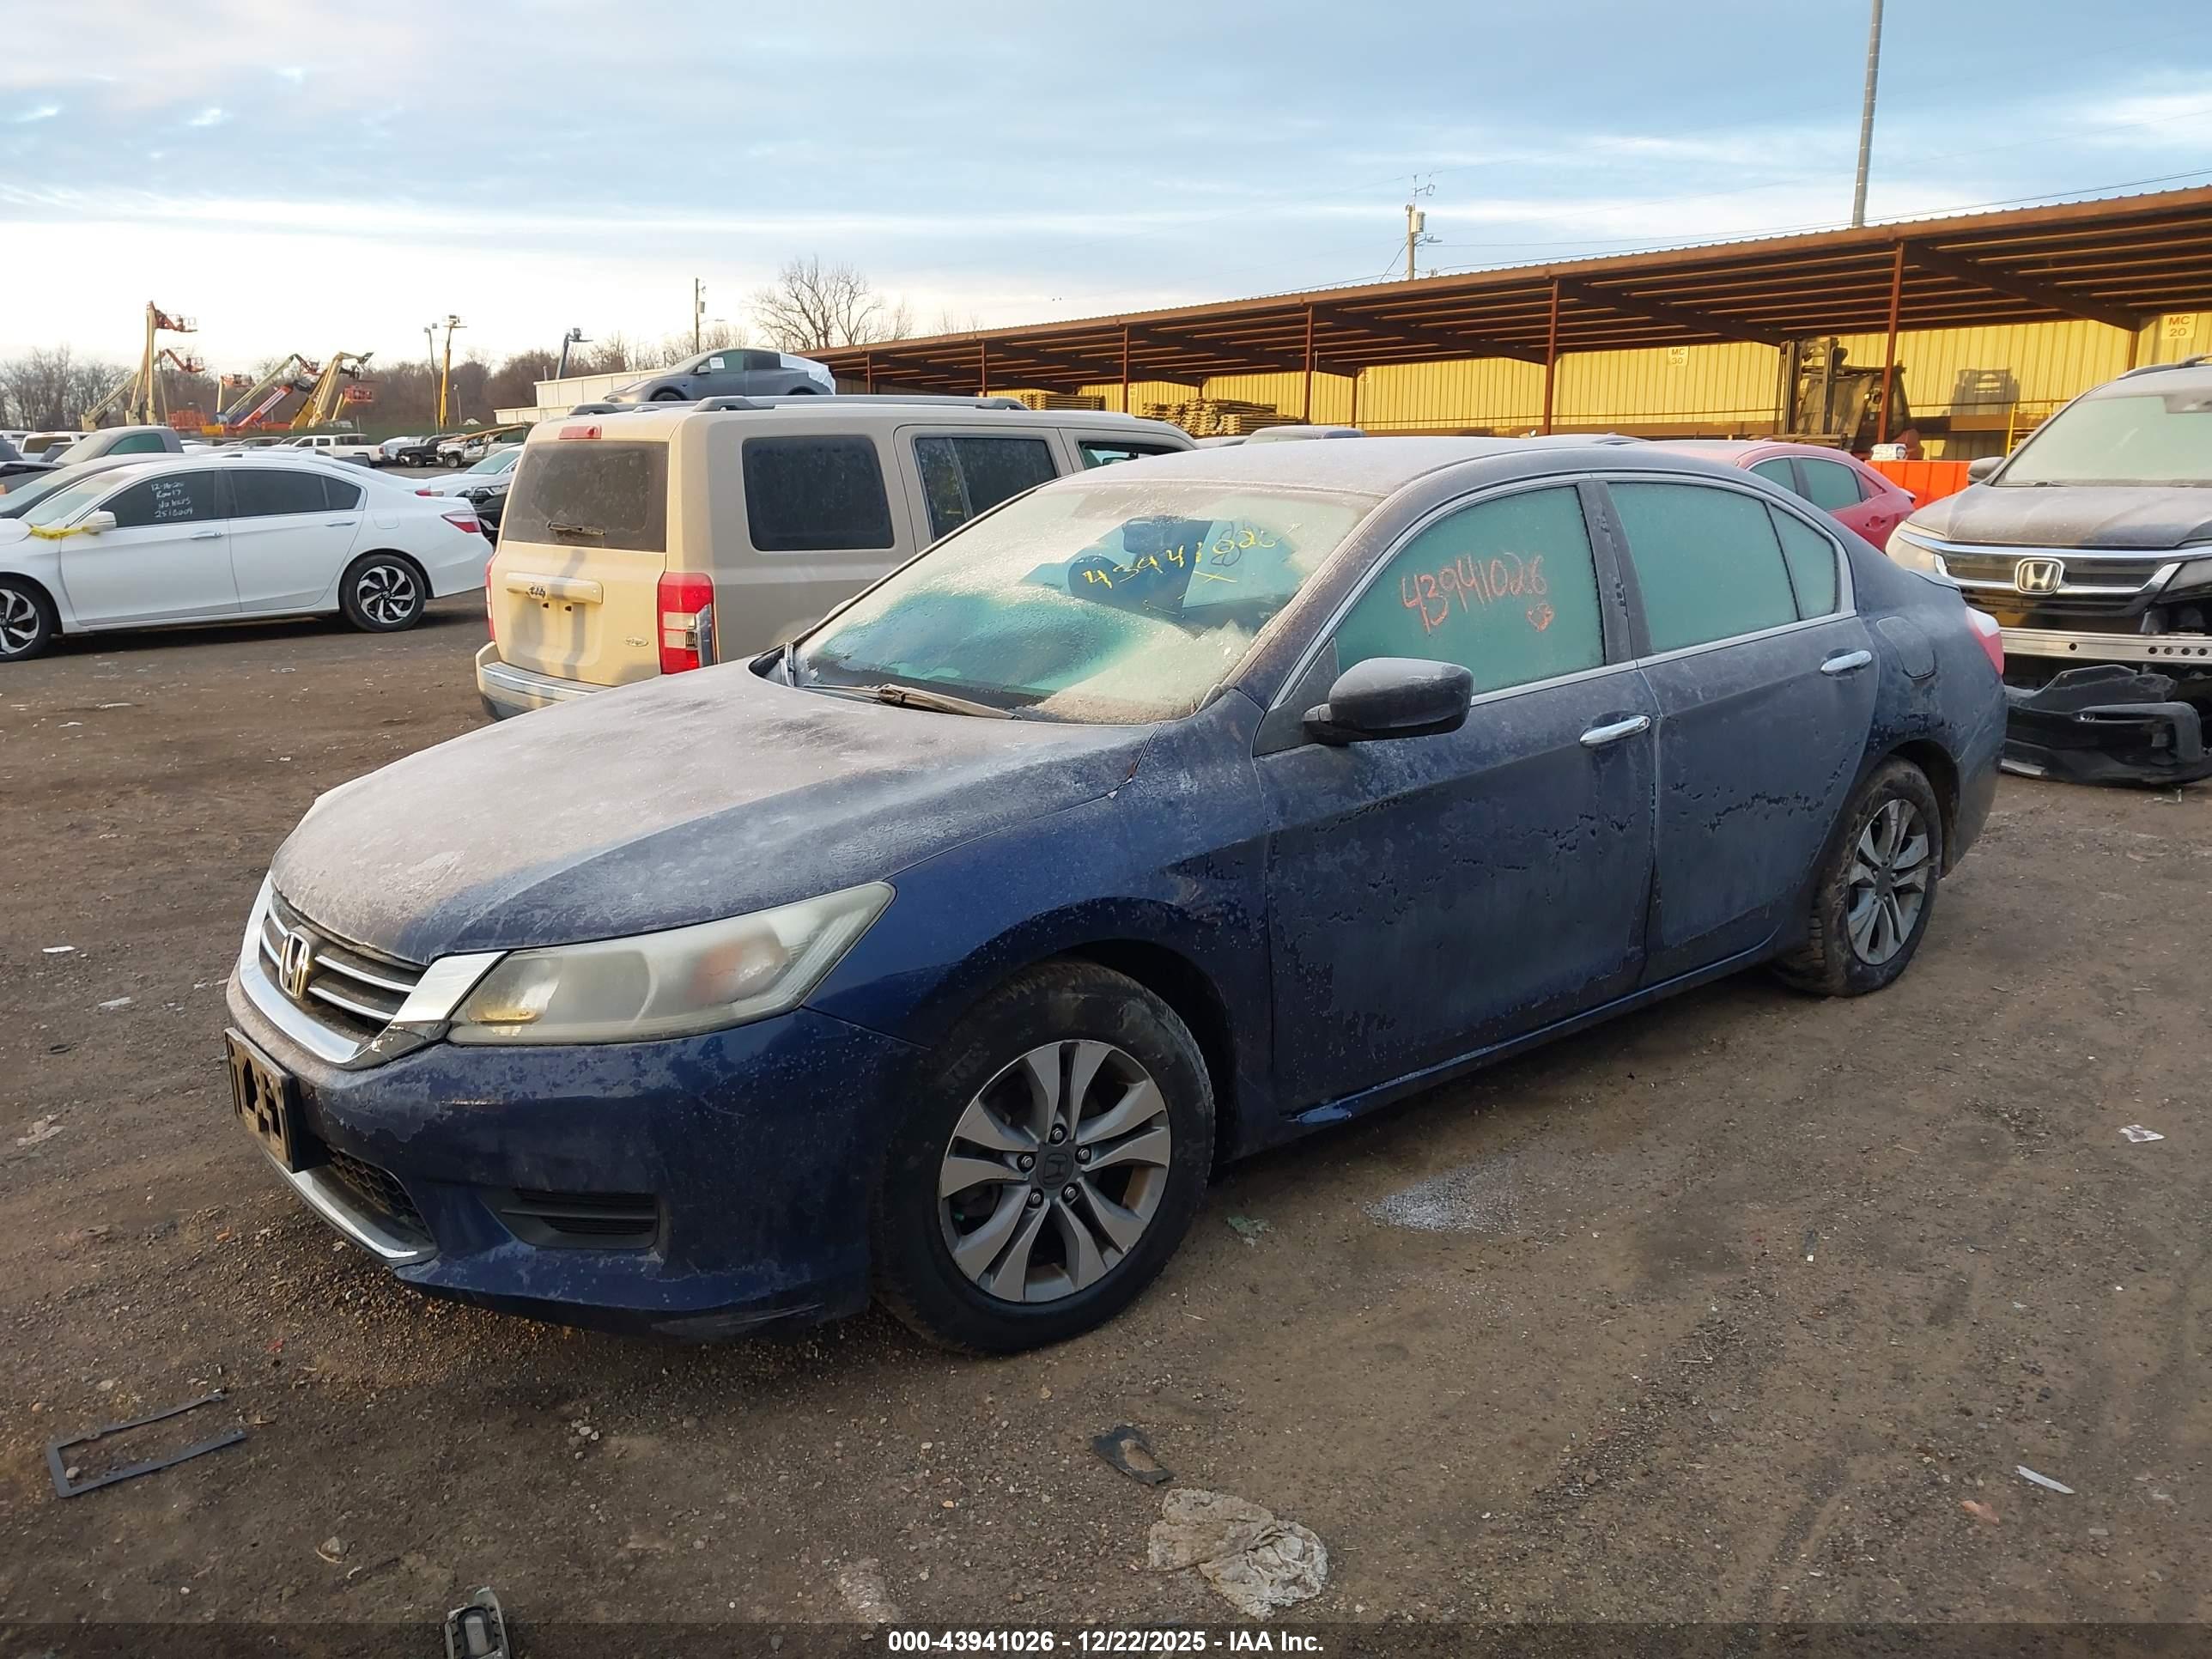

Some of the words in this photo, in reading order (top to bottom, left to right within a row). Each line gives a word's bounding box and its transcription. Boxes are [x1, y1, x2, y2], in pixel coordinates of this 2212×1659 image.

[2168, 315, 2191, 325] MC
[2169, 327, 2187, 337] 20
[1401, 551, 1547, 635] 43941026
